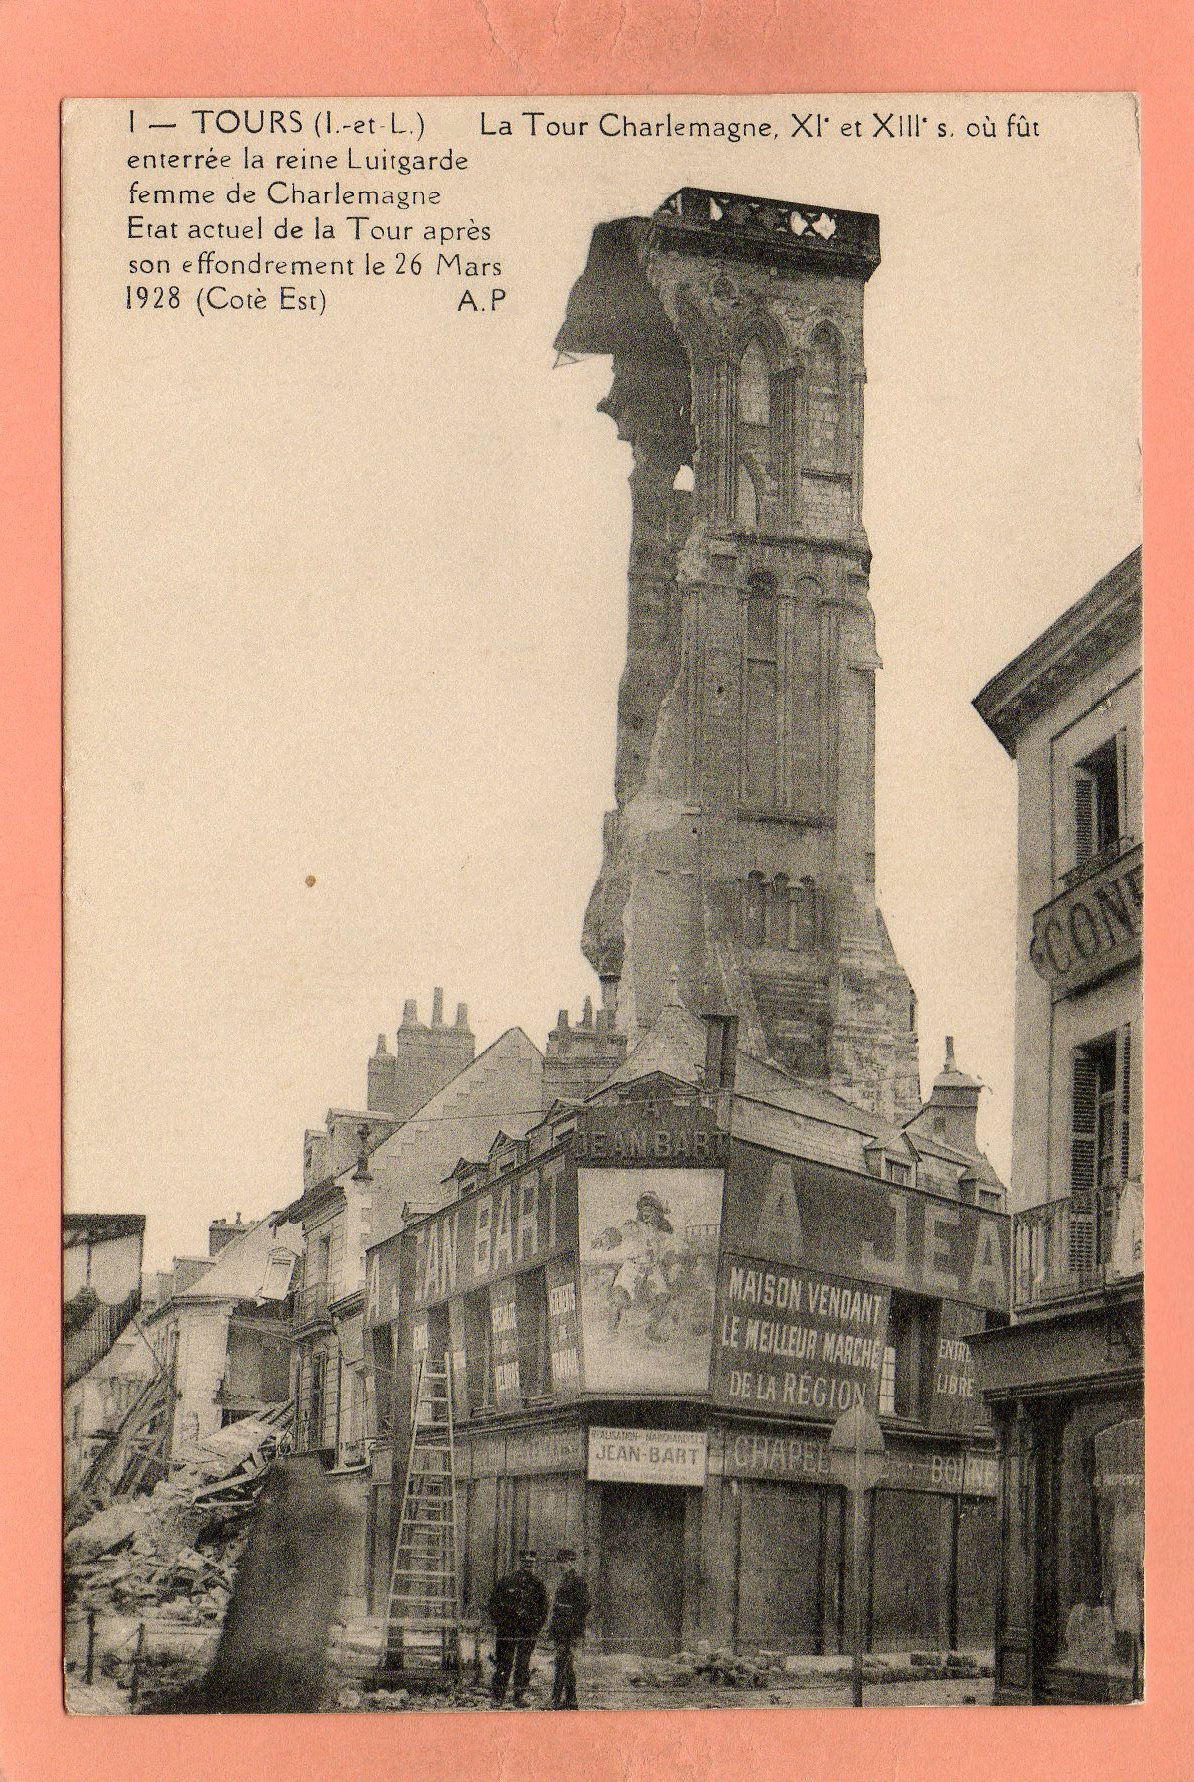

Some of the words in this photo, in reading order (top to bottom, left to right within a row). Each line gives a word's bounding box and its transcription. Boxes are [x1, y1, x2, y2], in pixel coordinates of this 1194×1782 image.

[574, 1130, 648, 1158] JEAN
[653, 1130, 728, 1159] BART
[473, 1154, 567, 1278] BART
[728, 1266, 803, 1310] MAISON
[807, 1281, 884, 1325] VENDANT
[721, 1314, 741, 1349] LE
[744, 1318, 818, 1361] MEILLEUR
[728, 1371, 753, 1399] DE
[756, 1374, 777, 1402] LA
[782, 1371, 867, 1410] RÉGION
[937, 1372, 975, 1397] LIBRE
[595, 1444, 701, 1466] JEAN-BART
